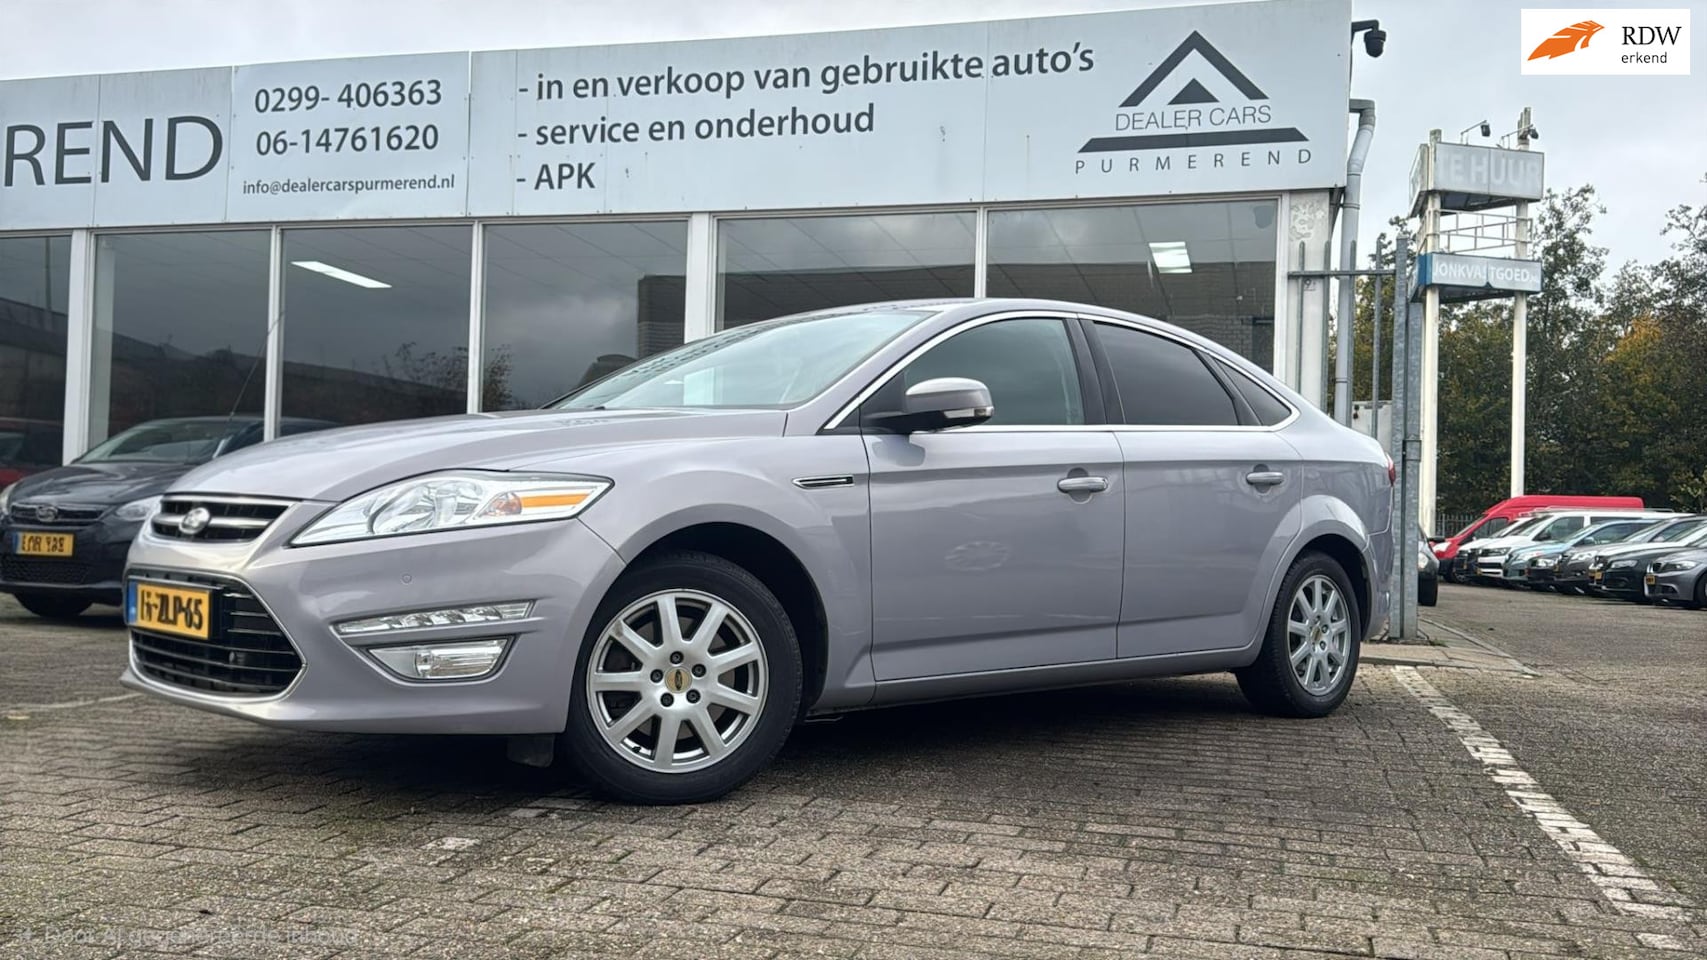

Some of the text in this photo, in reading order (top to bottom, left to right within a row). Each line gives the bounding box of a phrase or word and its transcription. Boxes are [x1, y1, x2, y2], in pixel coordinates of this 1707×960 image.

[536, 73, 563, 101] in
[572, 77, 609, 99] en
[616, 65, 745, 98] verkoop
[753, 68, 811, 90] van
[820, 50, 984, 94] gebruikte
[254, 79, 442, 114] 0299- 406363
[536, 115, 640, 146] service
[648, 120, 685, 142] en
[694, 102, 875, 140] onderhoud
[1115, 104, 1272, 131] DEALER CARS
[255, 124, 440, 156] 06-14761620
[534, 162, 596, 191] APK
[1075, 149, 1312, 174] PURMEREND
[242, 174, 456, 195] info@dealercarspurmerend.nl
